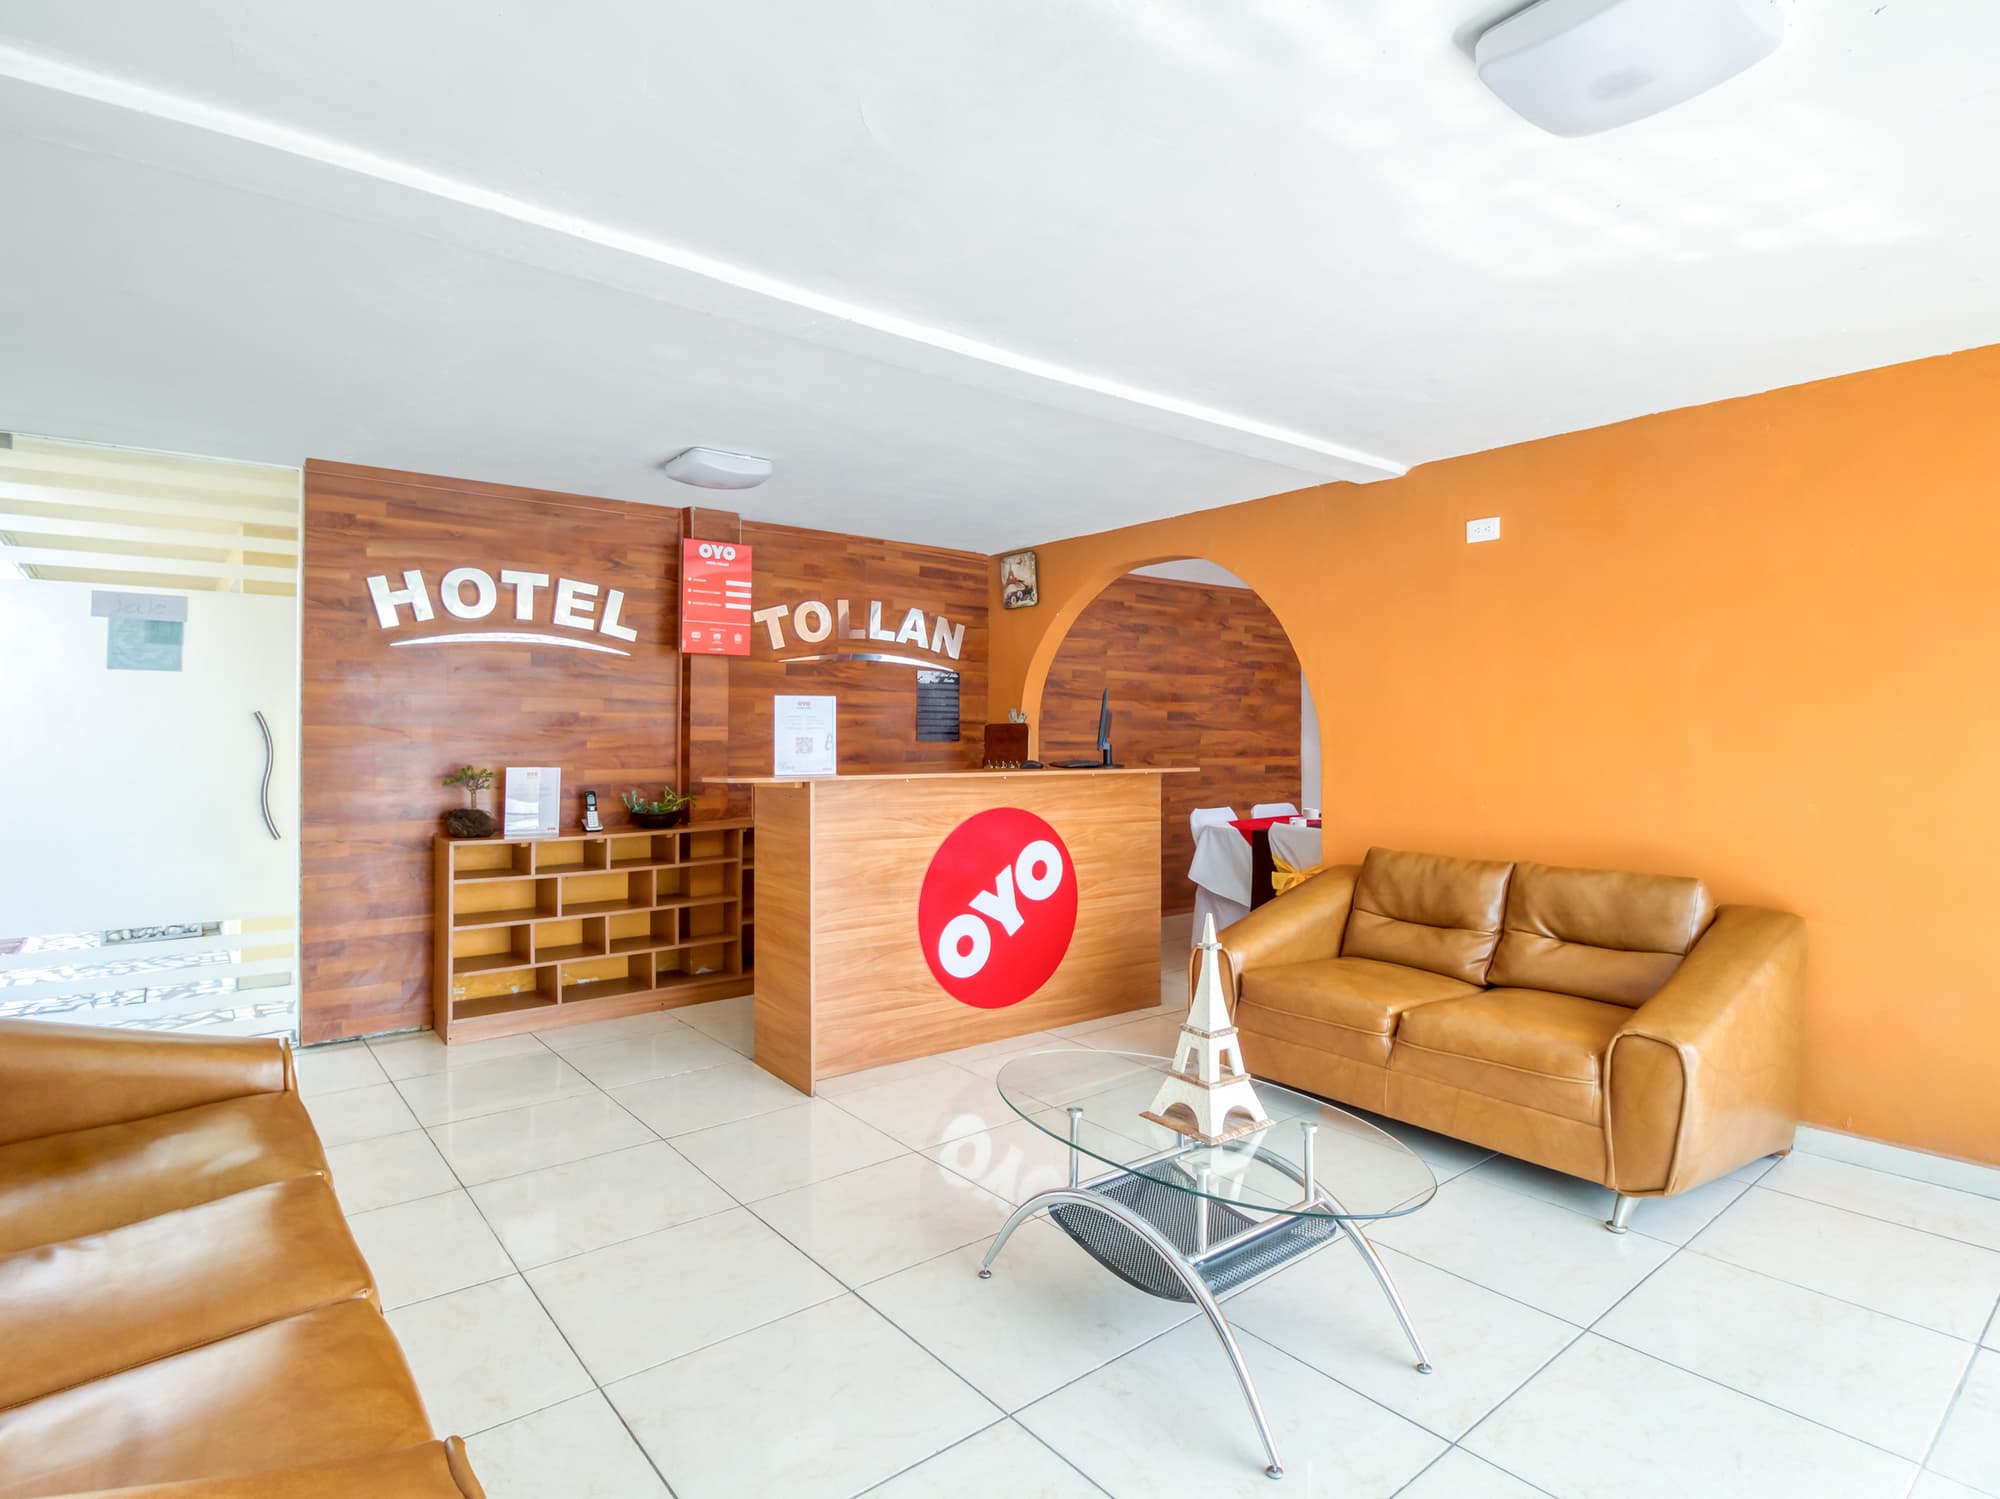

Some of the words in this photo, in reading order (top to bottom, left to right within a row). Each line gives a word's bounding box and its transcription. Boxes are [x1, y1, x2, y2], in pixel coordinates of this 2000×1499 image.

[698, 543, 737, 561] OYO
[366, 567, 638, 643] HOTEL
[752, 599, 966, 660] TOLLAN
[938, 840, 1064, 979] OYO
